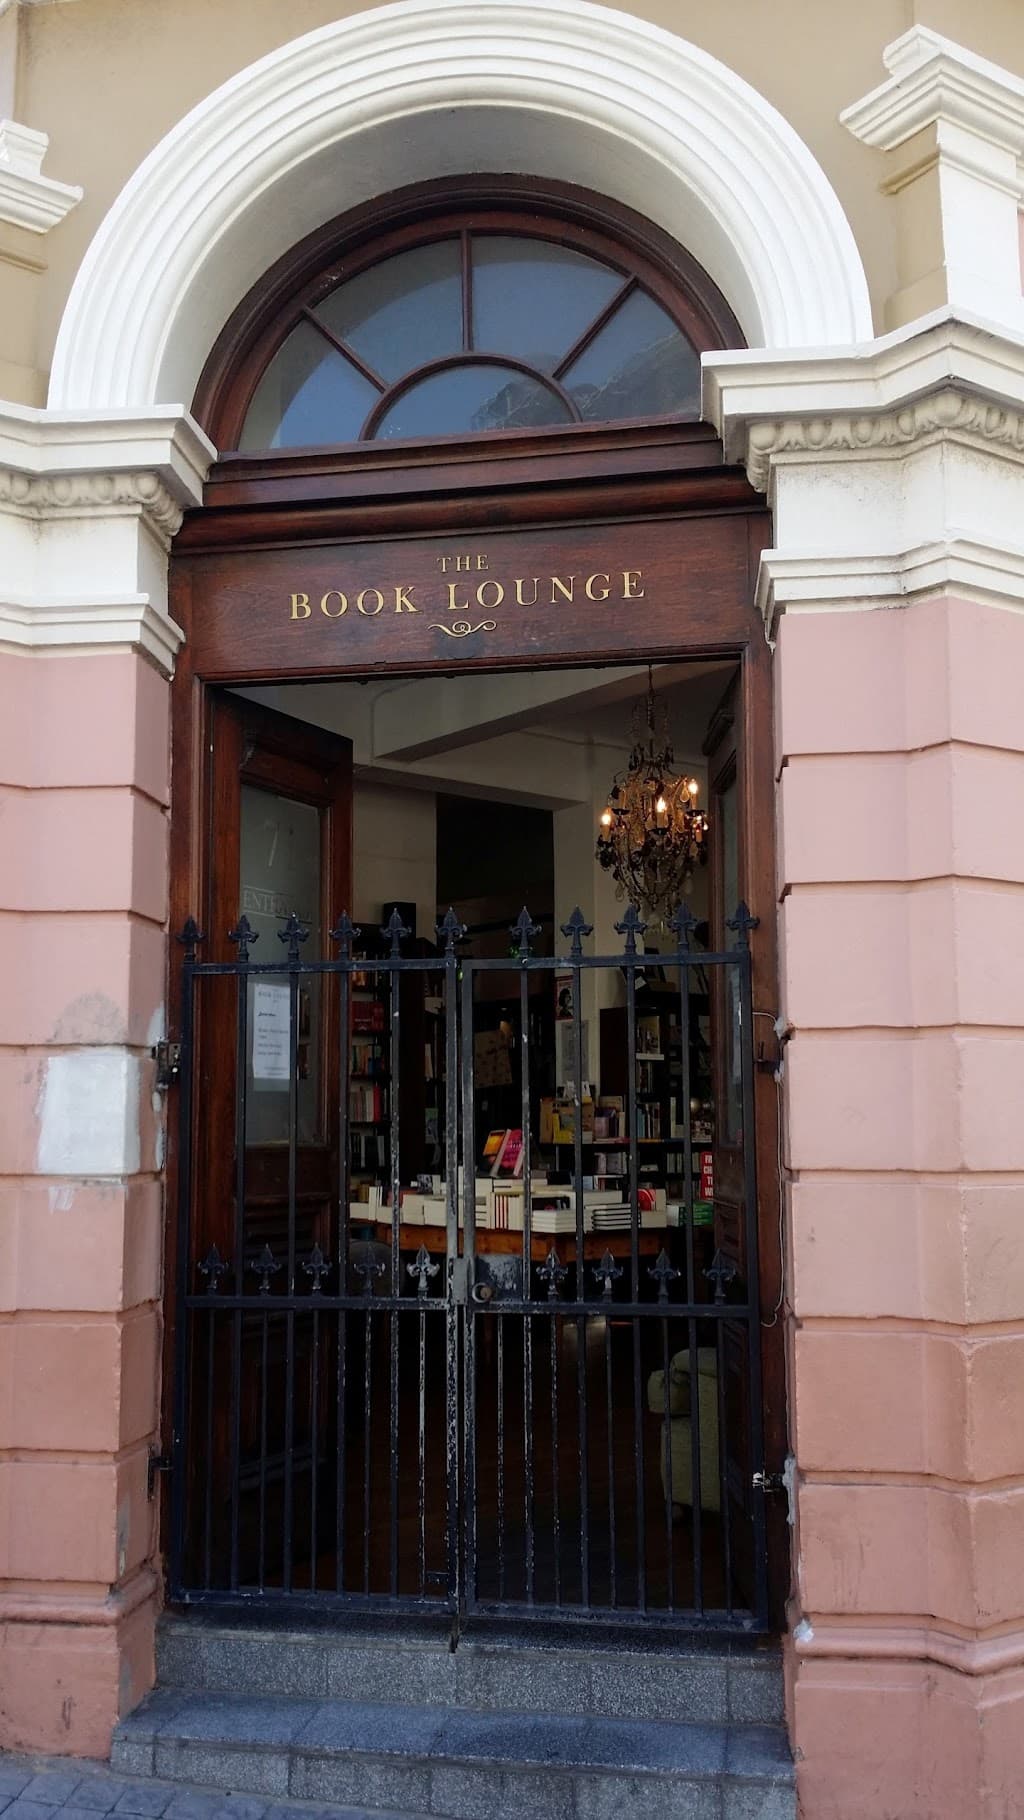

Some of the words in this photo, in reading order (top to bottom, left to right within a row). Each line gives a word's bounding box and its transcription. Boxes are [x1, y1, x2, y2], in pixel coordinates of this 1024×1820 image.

[437, 555, 489, 573] THE
[289, 586, 420, 620] BOOK
[447, 571, 645, 610] LOUNGE
